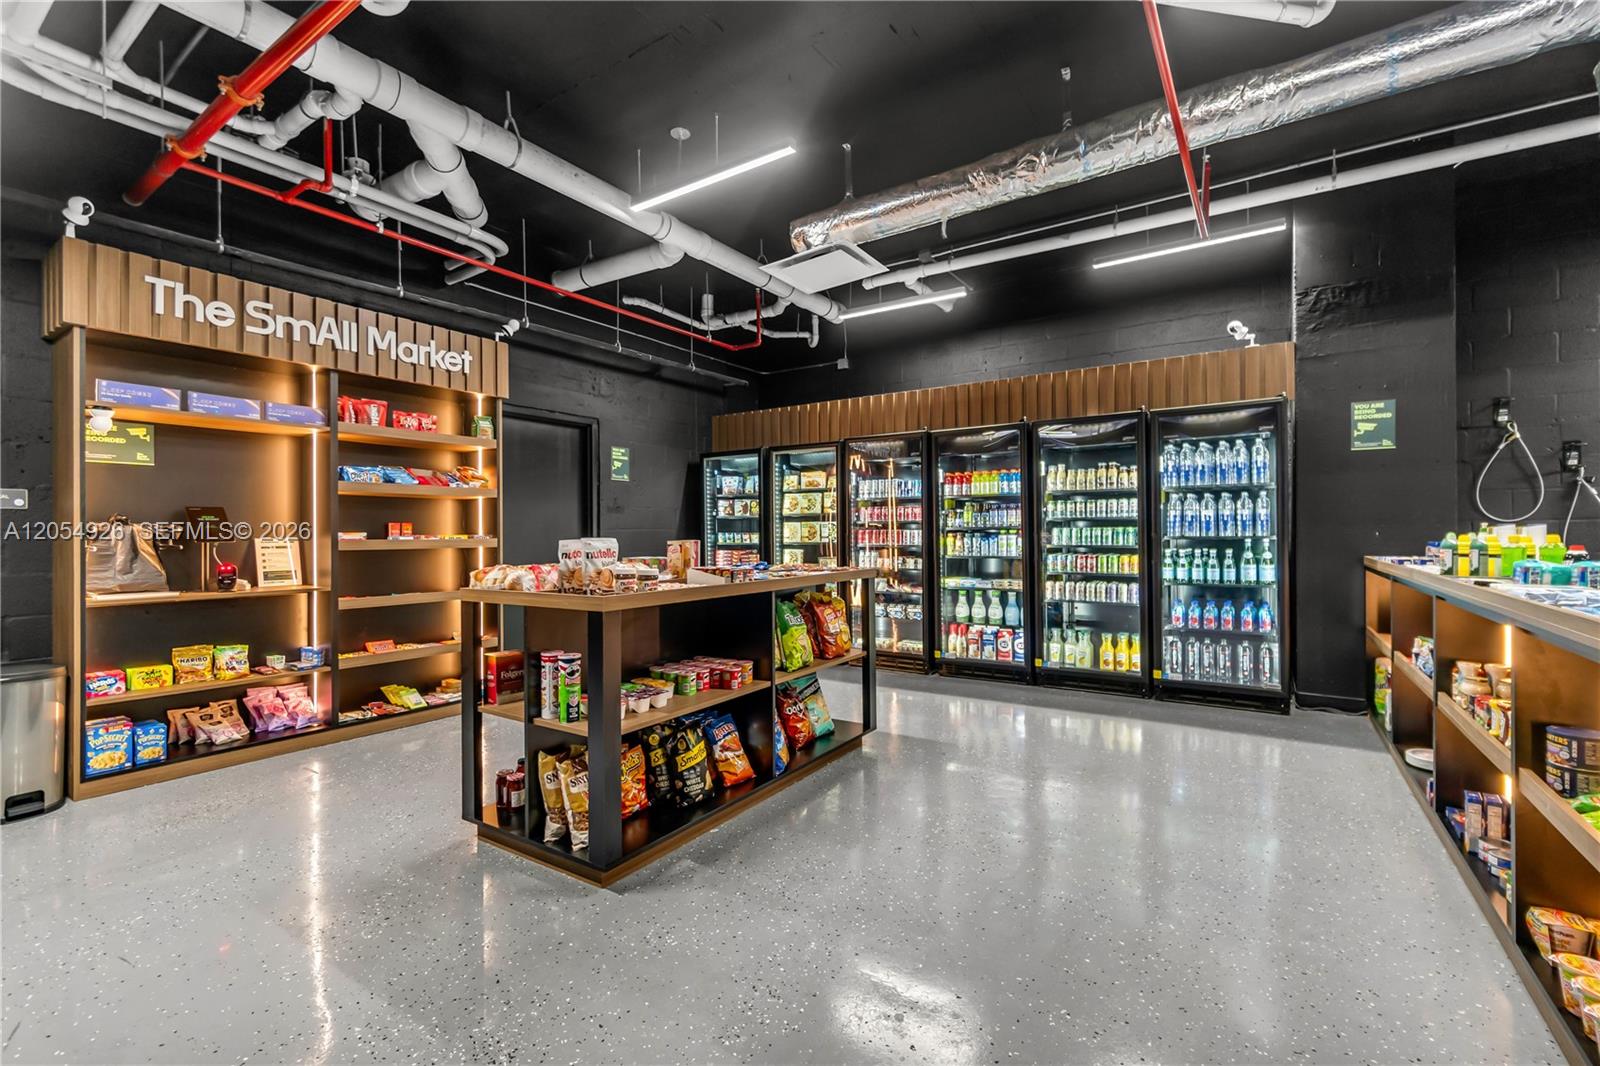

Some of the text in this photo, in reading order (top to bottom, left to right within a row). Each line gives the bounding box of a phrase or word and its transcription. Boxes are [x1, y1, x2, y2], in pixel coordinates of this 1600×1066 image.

[144, 275, 472, 374] The SmAll Market
[86, 435, 127, 445] ECORDED
